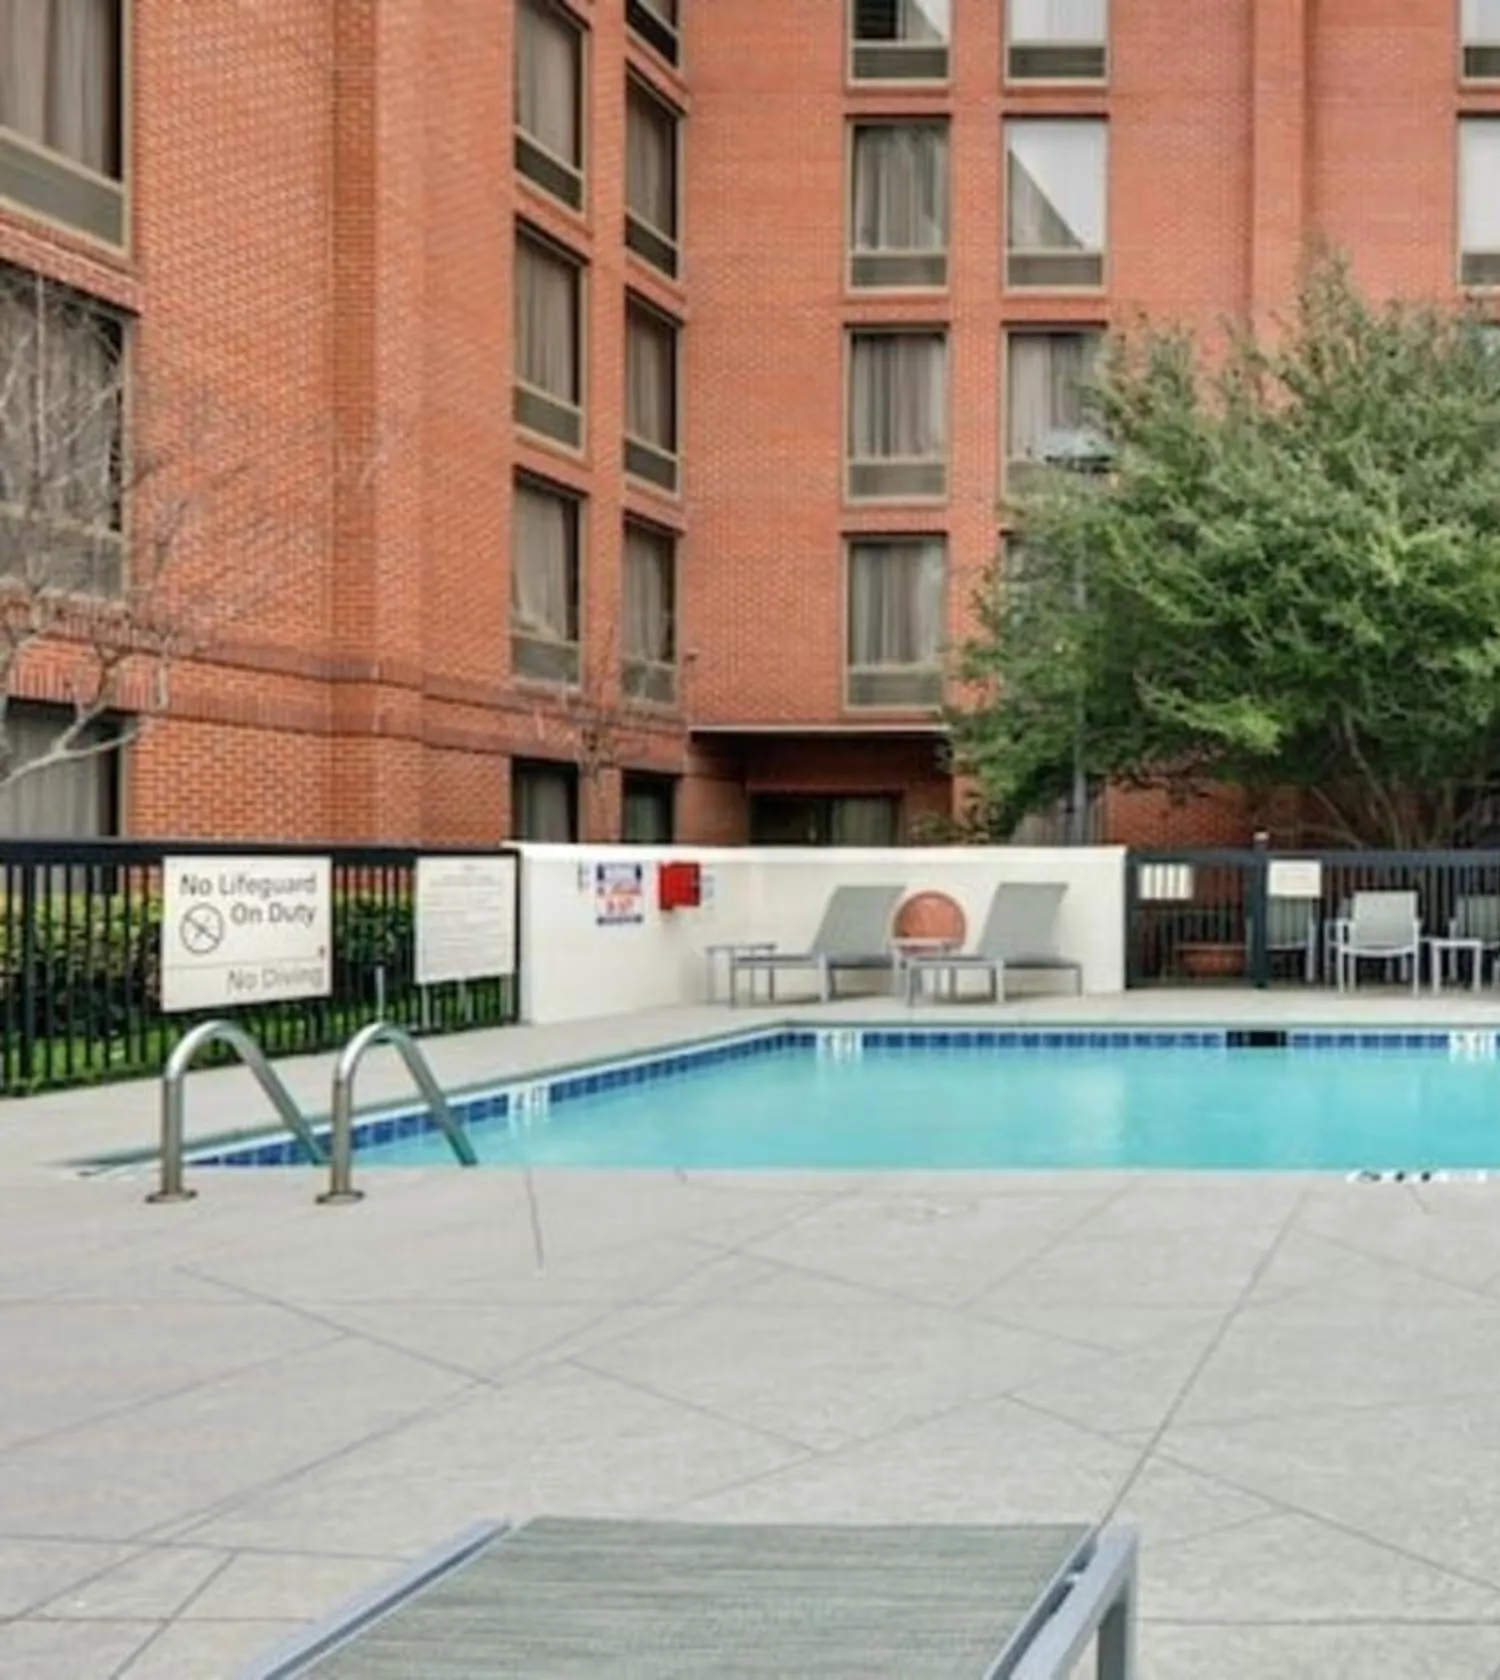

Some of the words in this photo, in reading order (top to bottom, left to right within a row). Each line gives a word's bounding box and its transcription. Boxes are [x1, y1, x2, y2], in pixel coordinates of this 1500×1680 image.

[179, 873, 213, 896] No
[218, 872, 316, 899] Lifeguard
[230, 902, 263, 925] On
[268, 902, 317, 928] Duty
[227, 969, 258, 993] No
[261, 967, 324, 989] Diving
